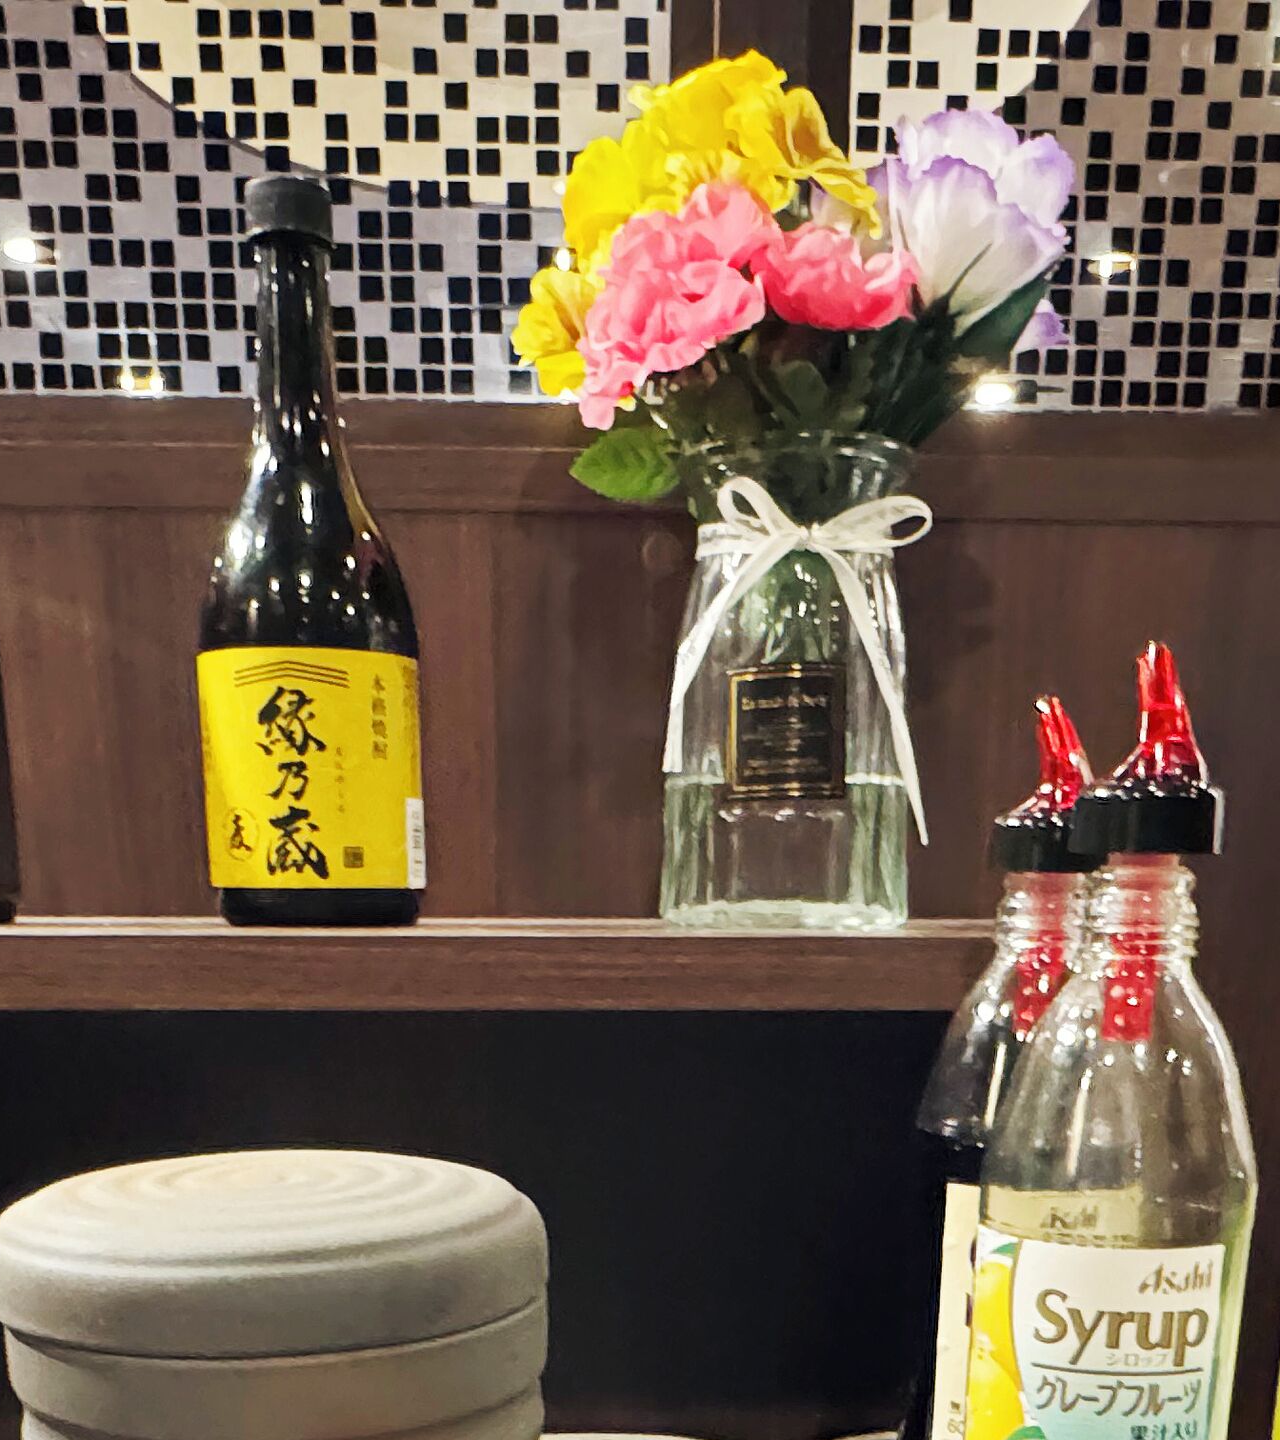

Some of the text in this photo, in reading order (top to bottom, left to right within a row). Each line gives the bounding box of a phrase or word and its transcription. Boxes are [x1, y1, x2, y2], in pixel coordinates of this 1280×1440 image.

[1138, 1259, 1215, 1295] Asahi
[1033, 1288, 1210, 1368] Syrup
[1034, 1374, 1203, 1418] グレープフルーツ
